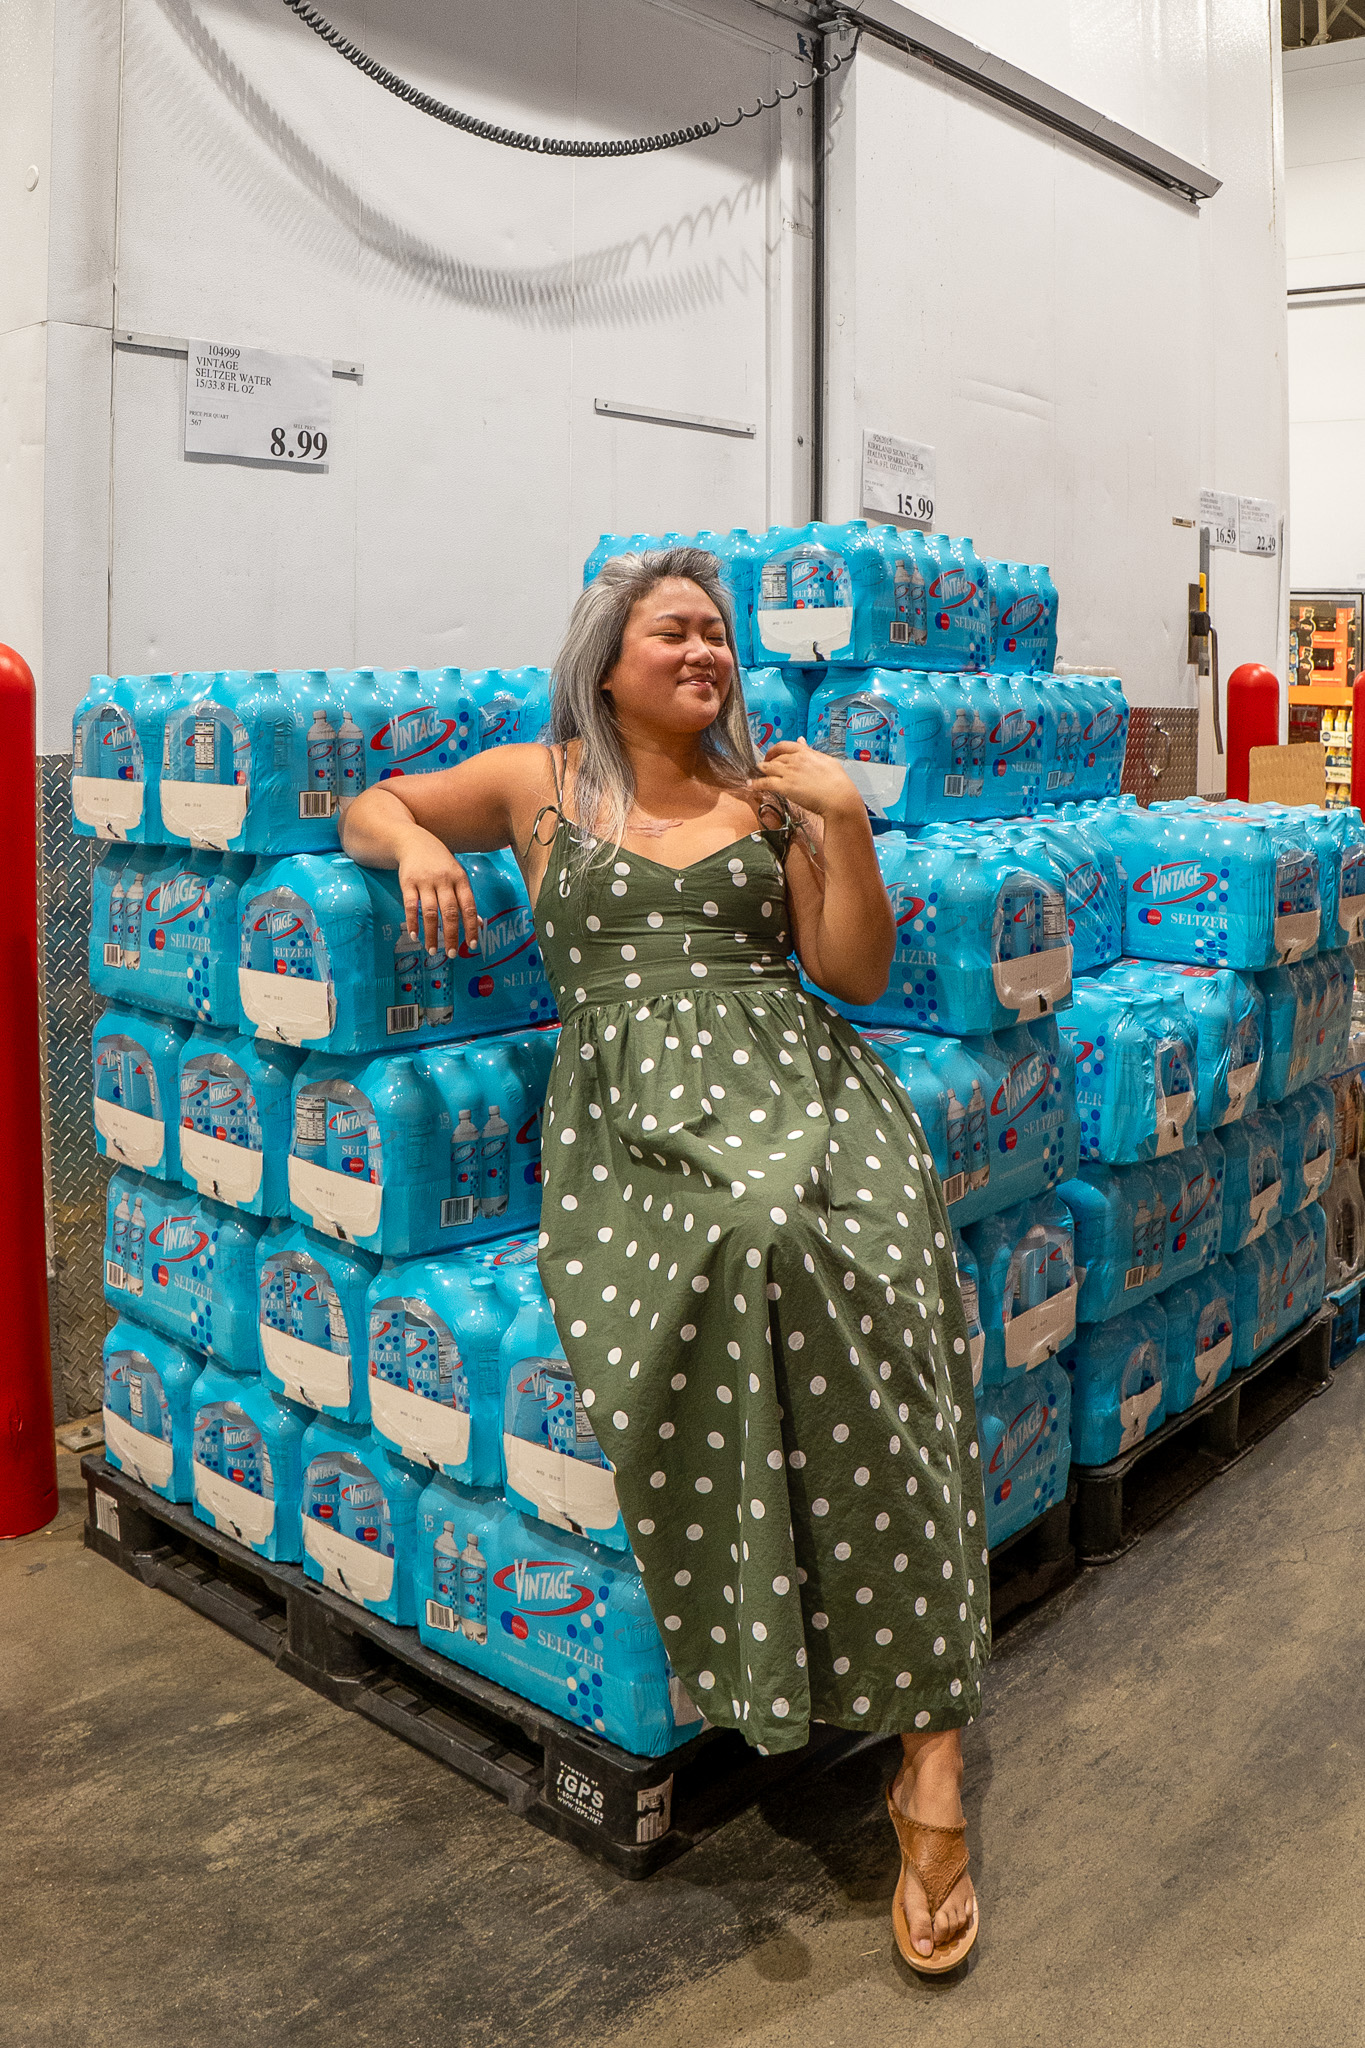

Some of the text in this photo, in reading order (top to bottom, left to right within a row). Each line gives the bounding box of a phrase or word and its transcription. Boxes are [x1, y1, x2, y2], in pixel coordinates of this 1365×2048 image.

[208, 345, 241, 359] 104999
[196, 356, 239, 371] VINTAGE
[195, 367, 272, 386] SELTZER WATER
[196, 378, 255, 395] 15/33.8 FL OZ
[270, 427, 328, 461] 8.99
[897, 493, 934, 521] 15.99
[1216, 527, 1237, 545] 16.59
[1256, 535, 1277, 552] 22.49
[954, 616, 987, 635] SELTZER
[1020, 637, 1049, 649] SELTZER
[389, 709, 442, 757] VINTAGE
[1150, 863, 1202, 900] VINTAGE
[158, 877, 201, 919] VINTAGE
[382, 924, 393, 936] 15
[1170, 912, 1229, 930] SELTZER
[170, 933, 212, 953] SELTZER
[478, 909, 530, 963] VINTAGE
[1001, 1055, 1044, 1118] VINTAGE
[439, 1112, 450, 1124] 15
[1022, 1109, 1065, 1135] SELTZER
[174, 1273, 213, 1303] SELTZER
[423, 1514, 434, 1528] 15
[514, 1558, 575, 1605] VINTAGE
[537, 1629, 605, 1672] SELTZER
[556, 1769, 605, 1810] iGPS
